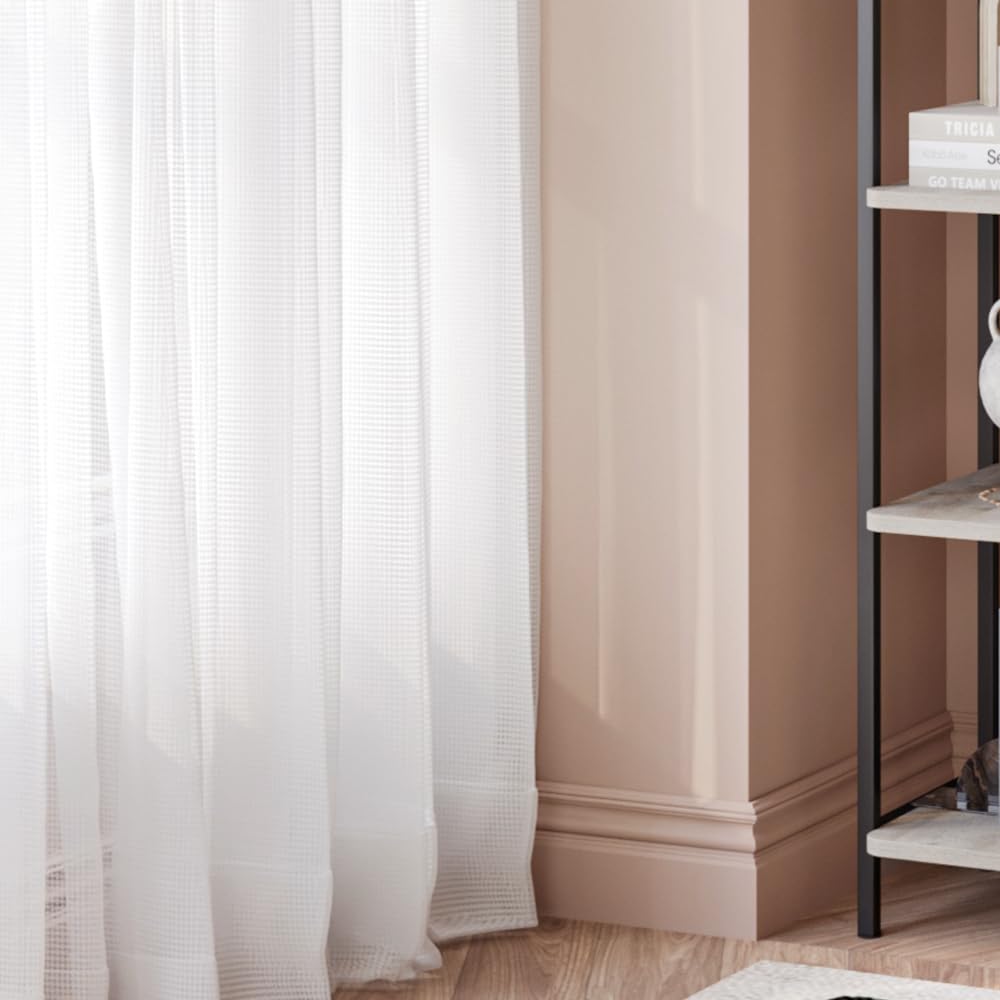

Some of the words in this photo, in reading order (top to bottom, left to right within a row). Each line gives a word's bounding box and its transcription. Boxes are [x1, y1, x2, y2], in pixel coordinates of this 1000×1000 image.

[945, 121, 995, 137] TRICIA
[928, 175, 947, 189] GO
[952, 177, 986, 191] TEAM
